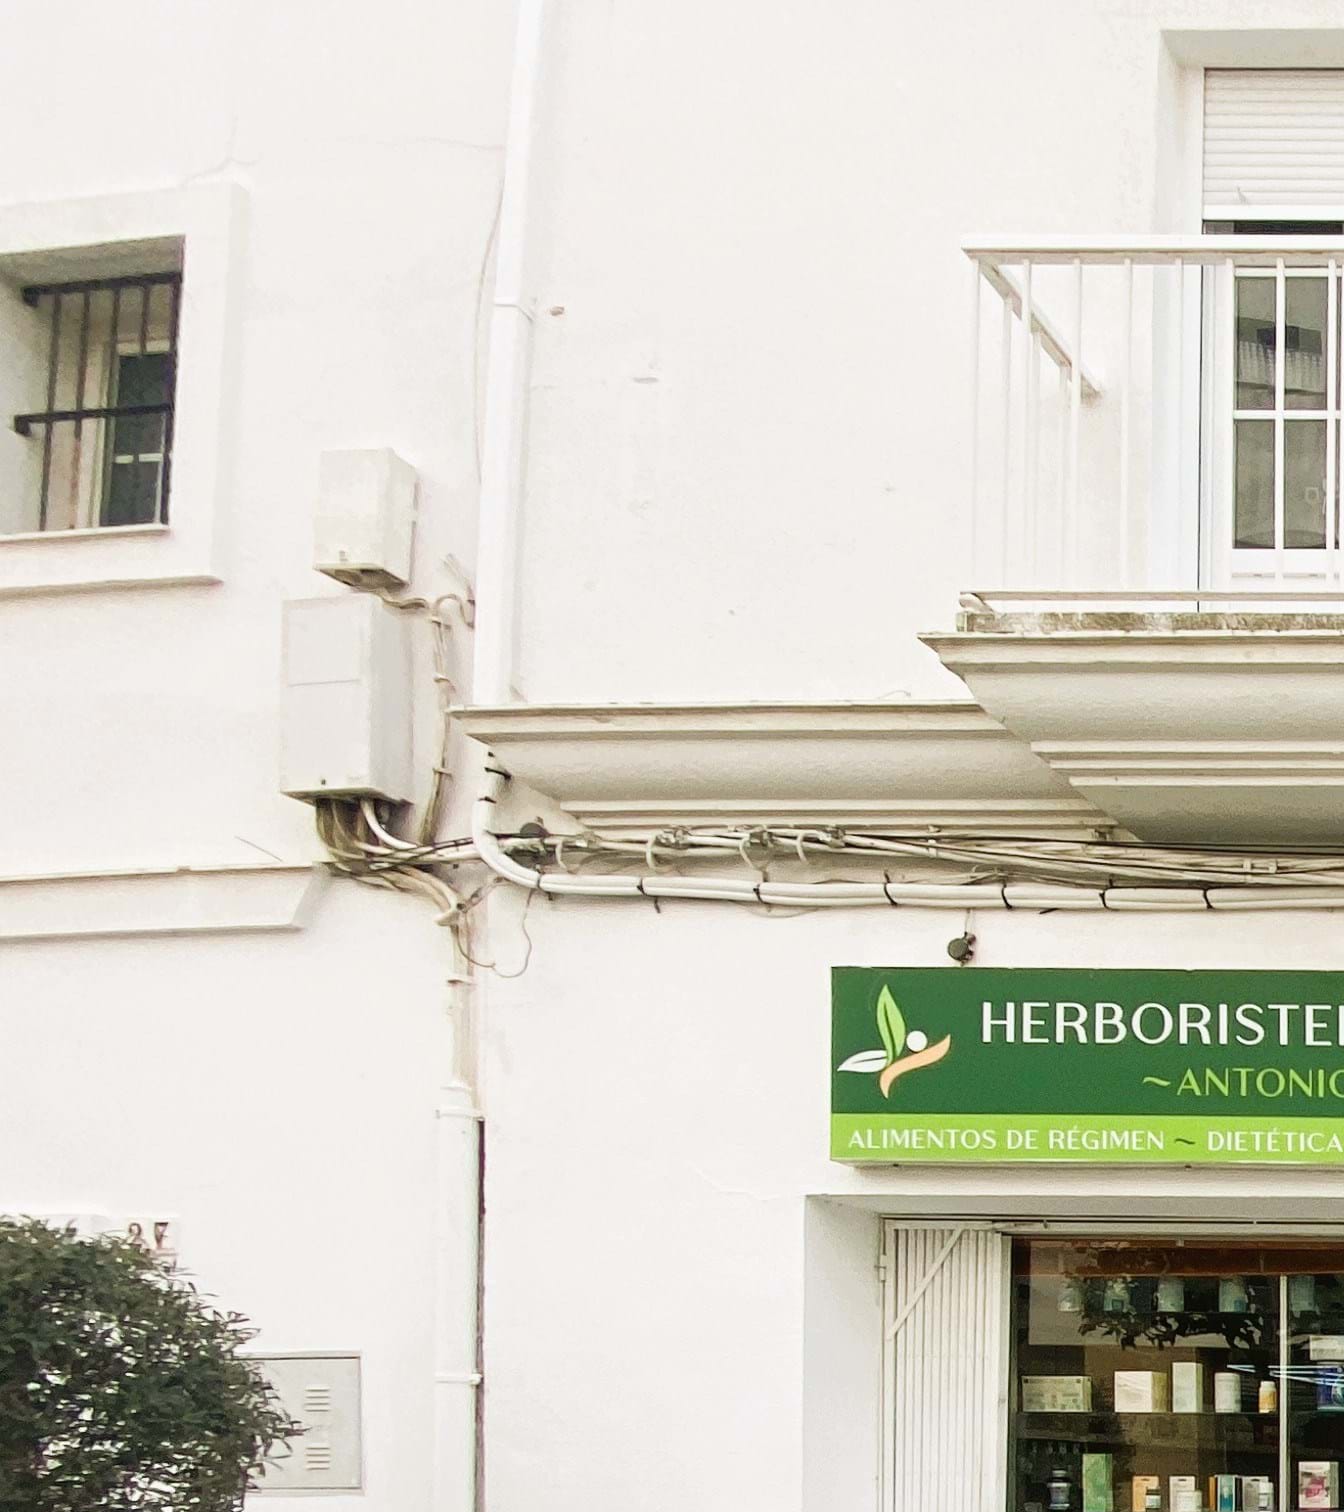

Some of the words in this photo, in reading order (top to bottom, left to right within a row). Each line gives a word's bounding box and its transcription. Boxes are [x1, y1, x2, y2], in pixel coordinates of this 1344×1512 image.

[848, 1129, 997, 1150] ALIMENTOS
[1006, 1130, 1038, 1150] DE
[1048, 1126, 1165, 1151] RÉGIMEN
[1208, 1128, 1343, 1153] DIETÉTICA
